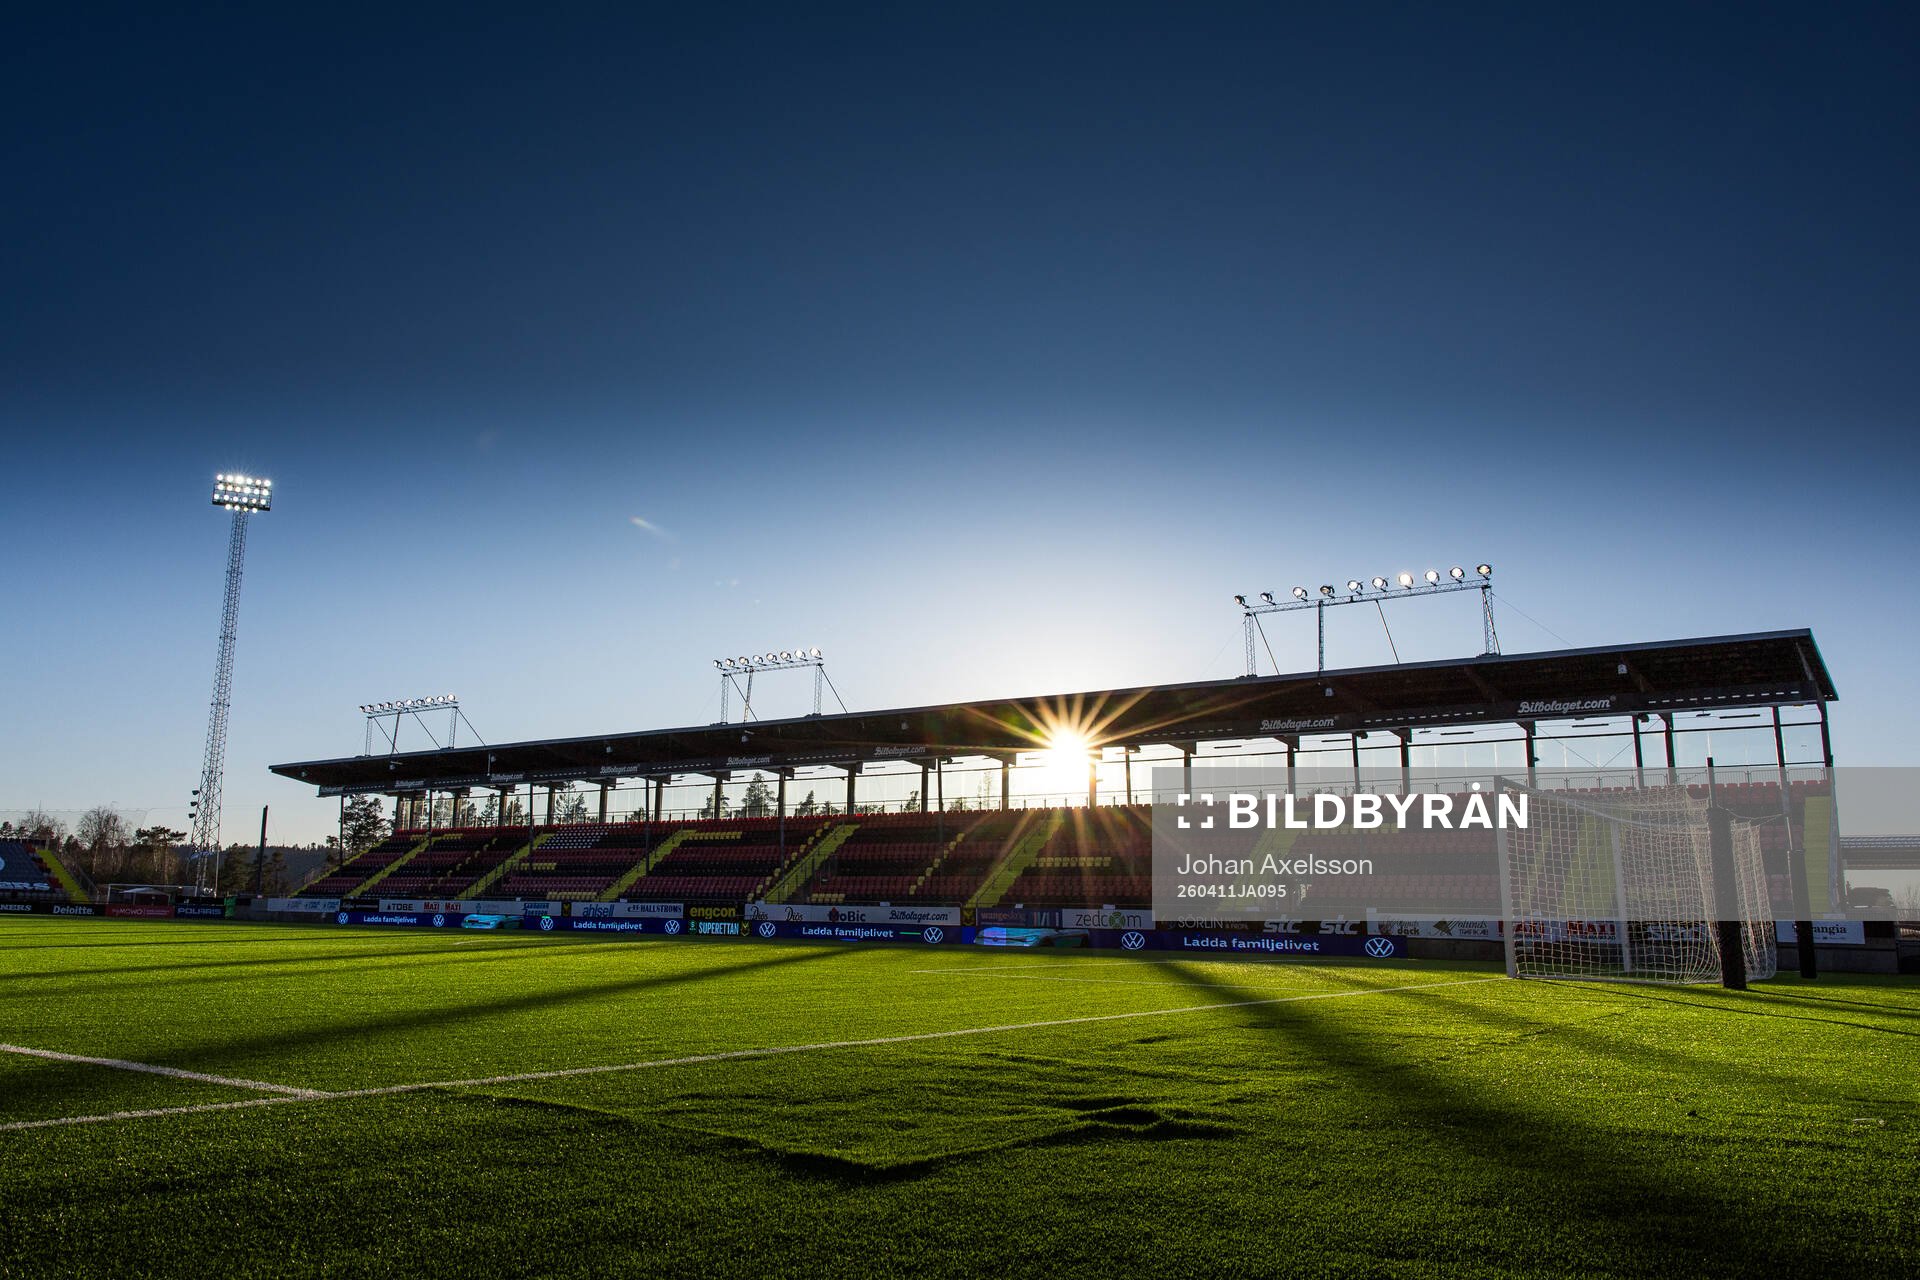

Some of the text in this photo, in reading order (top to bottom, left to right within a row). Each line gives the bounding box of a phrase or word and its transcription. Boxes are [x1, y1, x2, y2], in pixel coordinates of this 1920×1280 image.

[1517, 699, 1610, 714] Bilbolaget.com
[1259, 717, 1335, 732] Bilbolaget.com
[583, 904, 615, 917] ahlsell
[690, 906, 736, 919] engcon
[889, 910, 949, 923] Bilbolaget.com
[573, 921, 643, 931] Ladda familjelivet
[699, 921, 740, 935] SUPERETTAN
[1263, 914, 1304, 933] stc
[1319, 915, 1361, 935] stc
[802, 926, 894, 939] Ladda familjelivet
[1184, 936, 1320, 951] Ladda familjelivet
